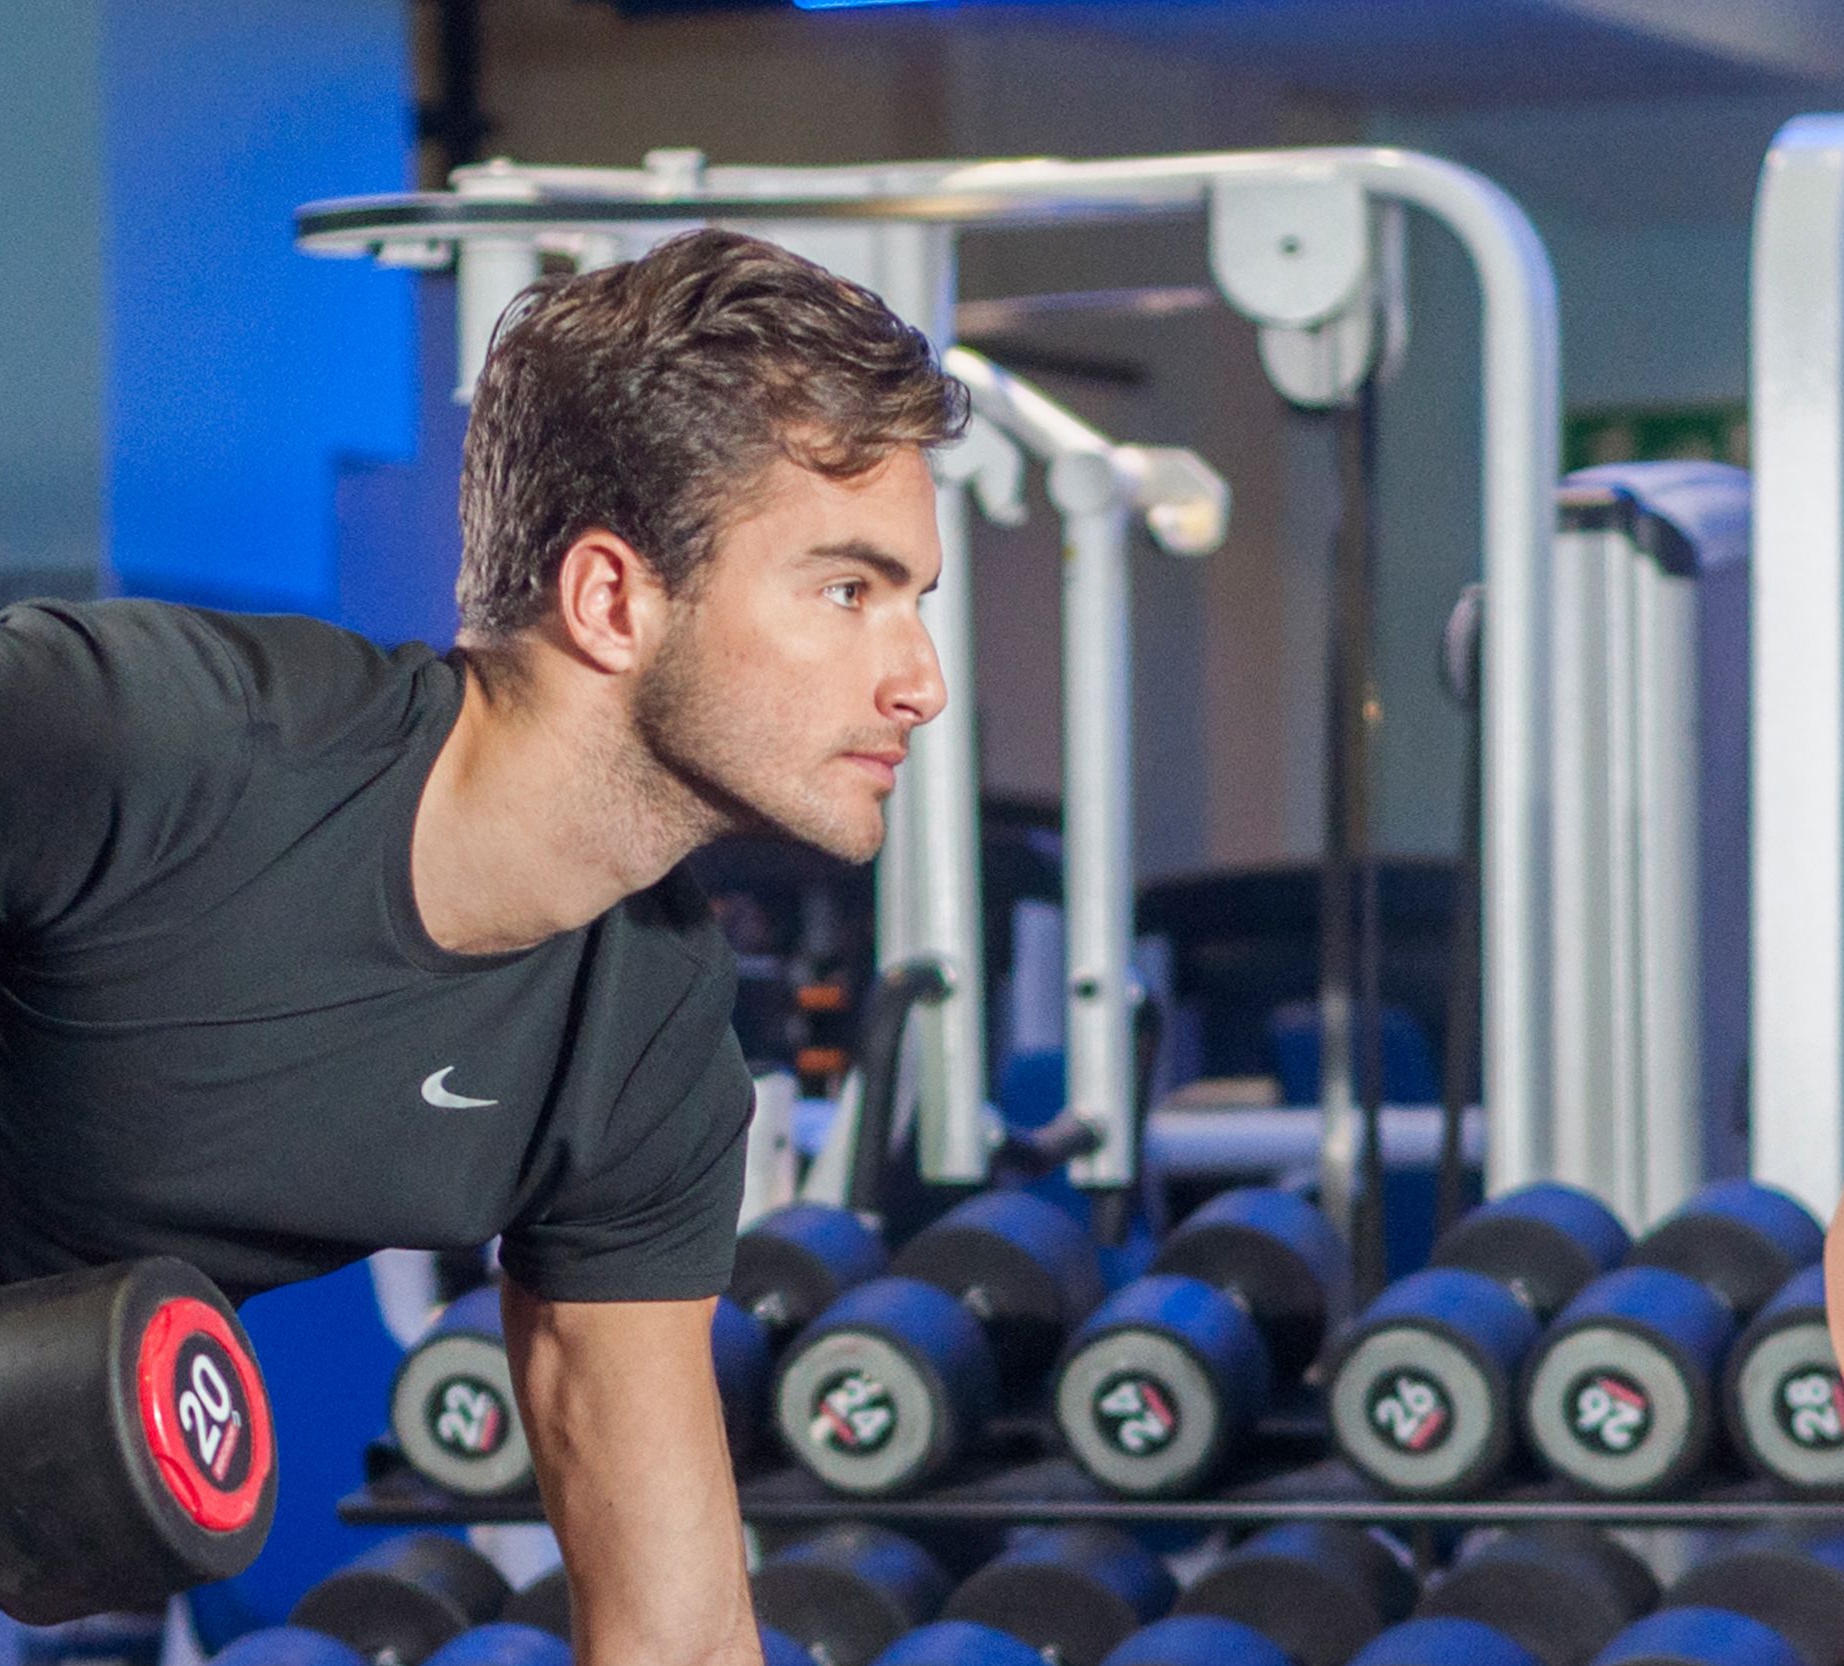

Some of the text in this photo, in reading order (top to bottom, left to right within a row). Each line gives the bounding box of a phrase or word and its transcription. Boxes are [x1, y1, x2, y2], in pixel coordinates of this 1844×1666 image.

[179, 1353, 232, 1466] 20
[438, 1385, 488, 1448] 22
[1100, 1384, 1164, 1450] 24
[1376, 1377, 1435, 1440] 26
[1578, 1387, 1641, 1448] 26
[1786, 1374, 1838, 1440] 28
